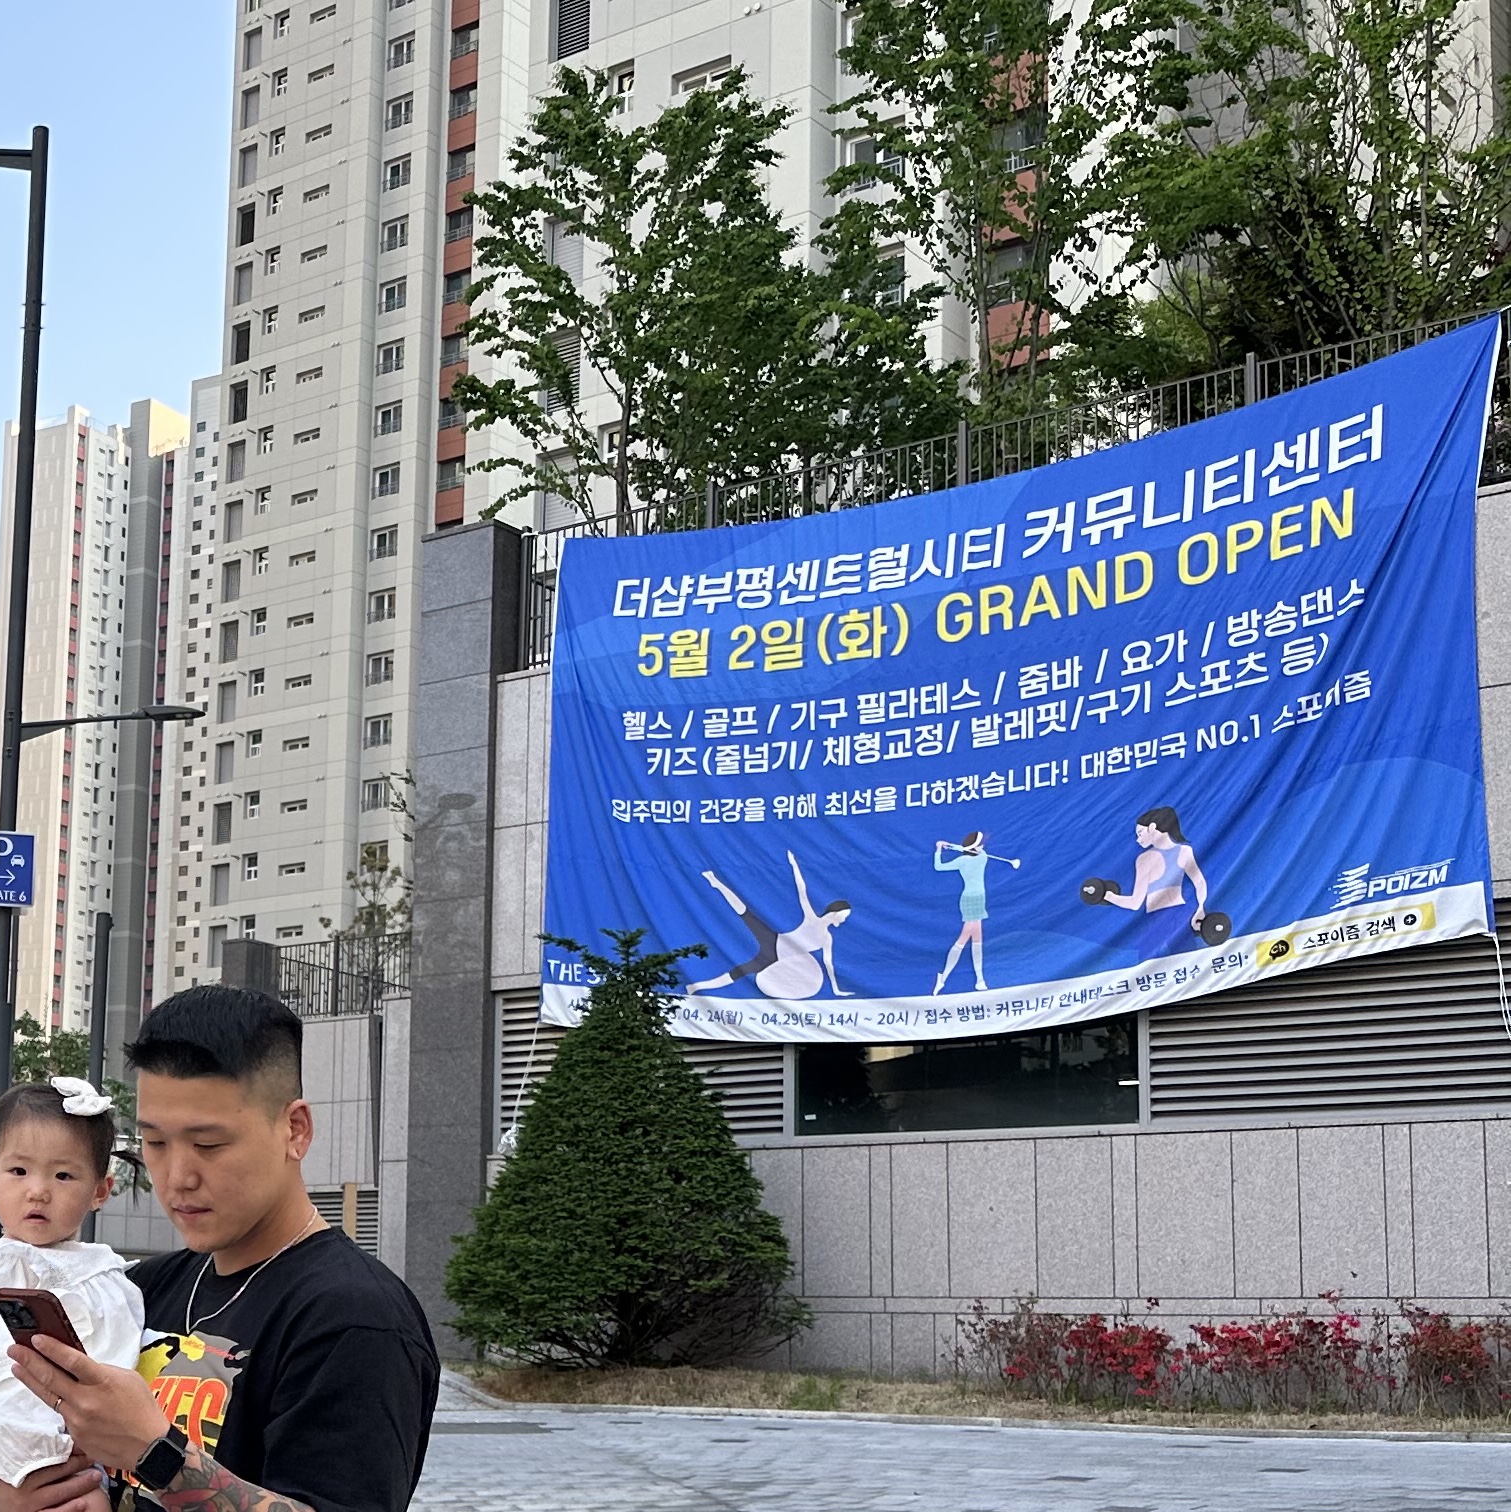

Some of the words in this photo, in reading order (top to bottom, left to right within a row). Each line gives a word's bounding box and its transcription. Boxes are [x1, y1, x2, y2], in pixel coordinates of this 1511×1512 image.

[612, 523, 1006, 619] 더샵부평센트럴시티
[1022, 403, 1384, 560] 커뮤니티센터
[637, 628, 711, 679] 5월
[935, 550, 1154, 643] GRAND
[1177, 487, 1354, 586] OPEN
[622, 711, 673, 741] 헬스
[703, 706, 759, 739] 골프
[790, 697, 848, 732] 기구
[856, 677, 981, 725] 필라테스
[1018, 655, 1083, 700] 줌바
[1121, 629, 1188, 675] 요가
[1226, 578, 1366, 647] 방송댄스
[1165, 652, 1270, 708] 스포츠
[1280, 633, 1329, 677] 등)
[611, 798, 690, 824] 입주민의
[699, 797, 766, 823] 건강을
[772, 793, 817, 820] 위해
[823, 786, 898, 816] 최선을
[905, 760, 1069, 807] 다하겠습니다!
[1080, 731, 1187, 781] 대한민국
[1196, 714, 1261, 752] NO.1
[19, 891, 27, 902] 6
[1302, 924, 1360, 949] 스포이즘
[1366, 916, 1396, 936] 검색
[547, 958, 584, 983] THE
[828, 1011, 858, 1027] 14시
[877, 1010, 909, 1026] 20시
[924, 1008, 953, 1025] 접수
[996, 994, 1054, 1018] 커뮤니티
[1135, 971, 1167, 992] 방문
